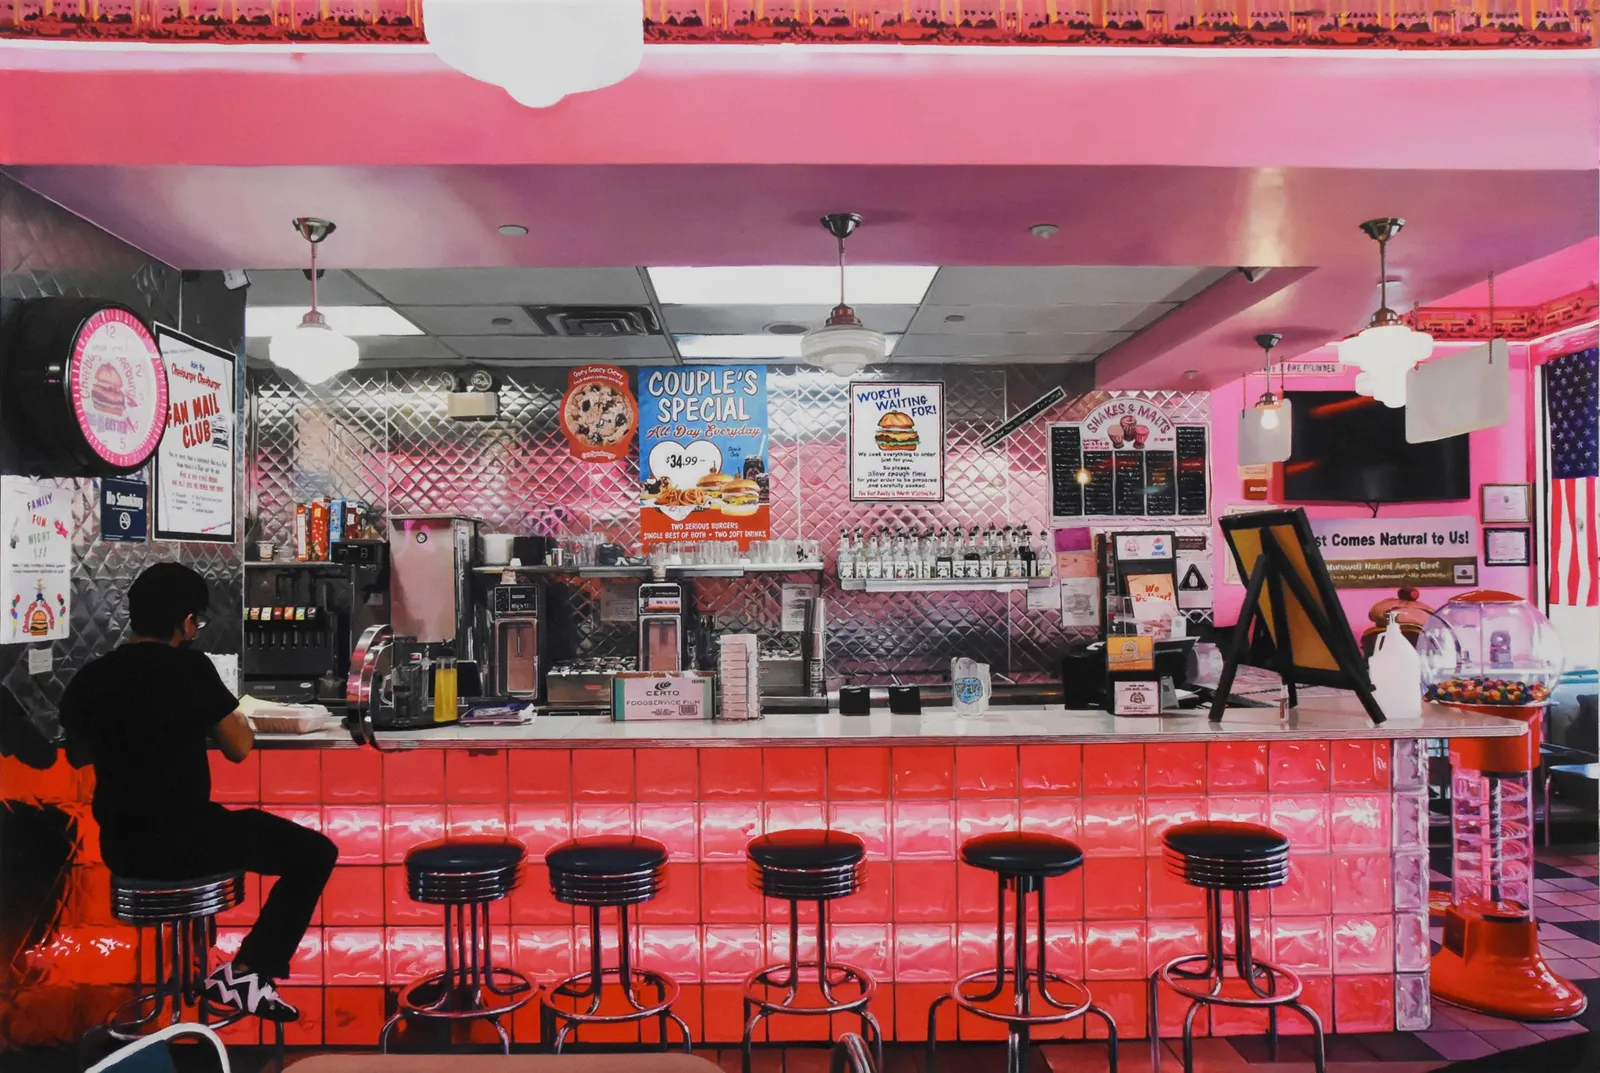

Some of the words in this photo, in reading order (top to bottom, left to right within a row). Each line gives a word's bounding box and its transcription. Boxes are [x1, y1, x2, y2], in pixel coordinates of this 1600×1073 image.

[648, 368, 758, 396] COUPLE'S
[857, 388, 901, 403] WORTH
[875, 395, 928, 412] WAITING
[192, 393, 220, 420] MAIL
[656, 397, 751, 424] SPECIAL
[912, 405, 937, 417] FOR!
[1087, 403, 1125, 434] SHAKES
[1127, 404, 1136, 415] &
[1137, 405, 1171, 435] MALTS
[183, 420, 211, 448] CLUB
[645, 424, 669, 440] All
[674, 424, 700, 440] Day
[705, 422, 761, 440] Everyday
[666, 454, 698, 469] $34.99
[27, 492, 53, 512] FAMILY
[106, 491, 116, 505] No
[116, 492, 144, 510] Smoking
[32, 514, 47, 528] FUN
[28, 531, 52, 545] NIGHT
[1315, 535, 1327, 547] st
[1332, 533, 1375, 547] Comes
[1380, 532, 1427, 546] Natural
[1431, 532, 1444, 545] to
[1449, 530, 1469, 545] Us!
[1364, 562, 1393, 571] Natural
[1145, 584, 1159, 592] We
